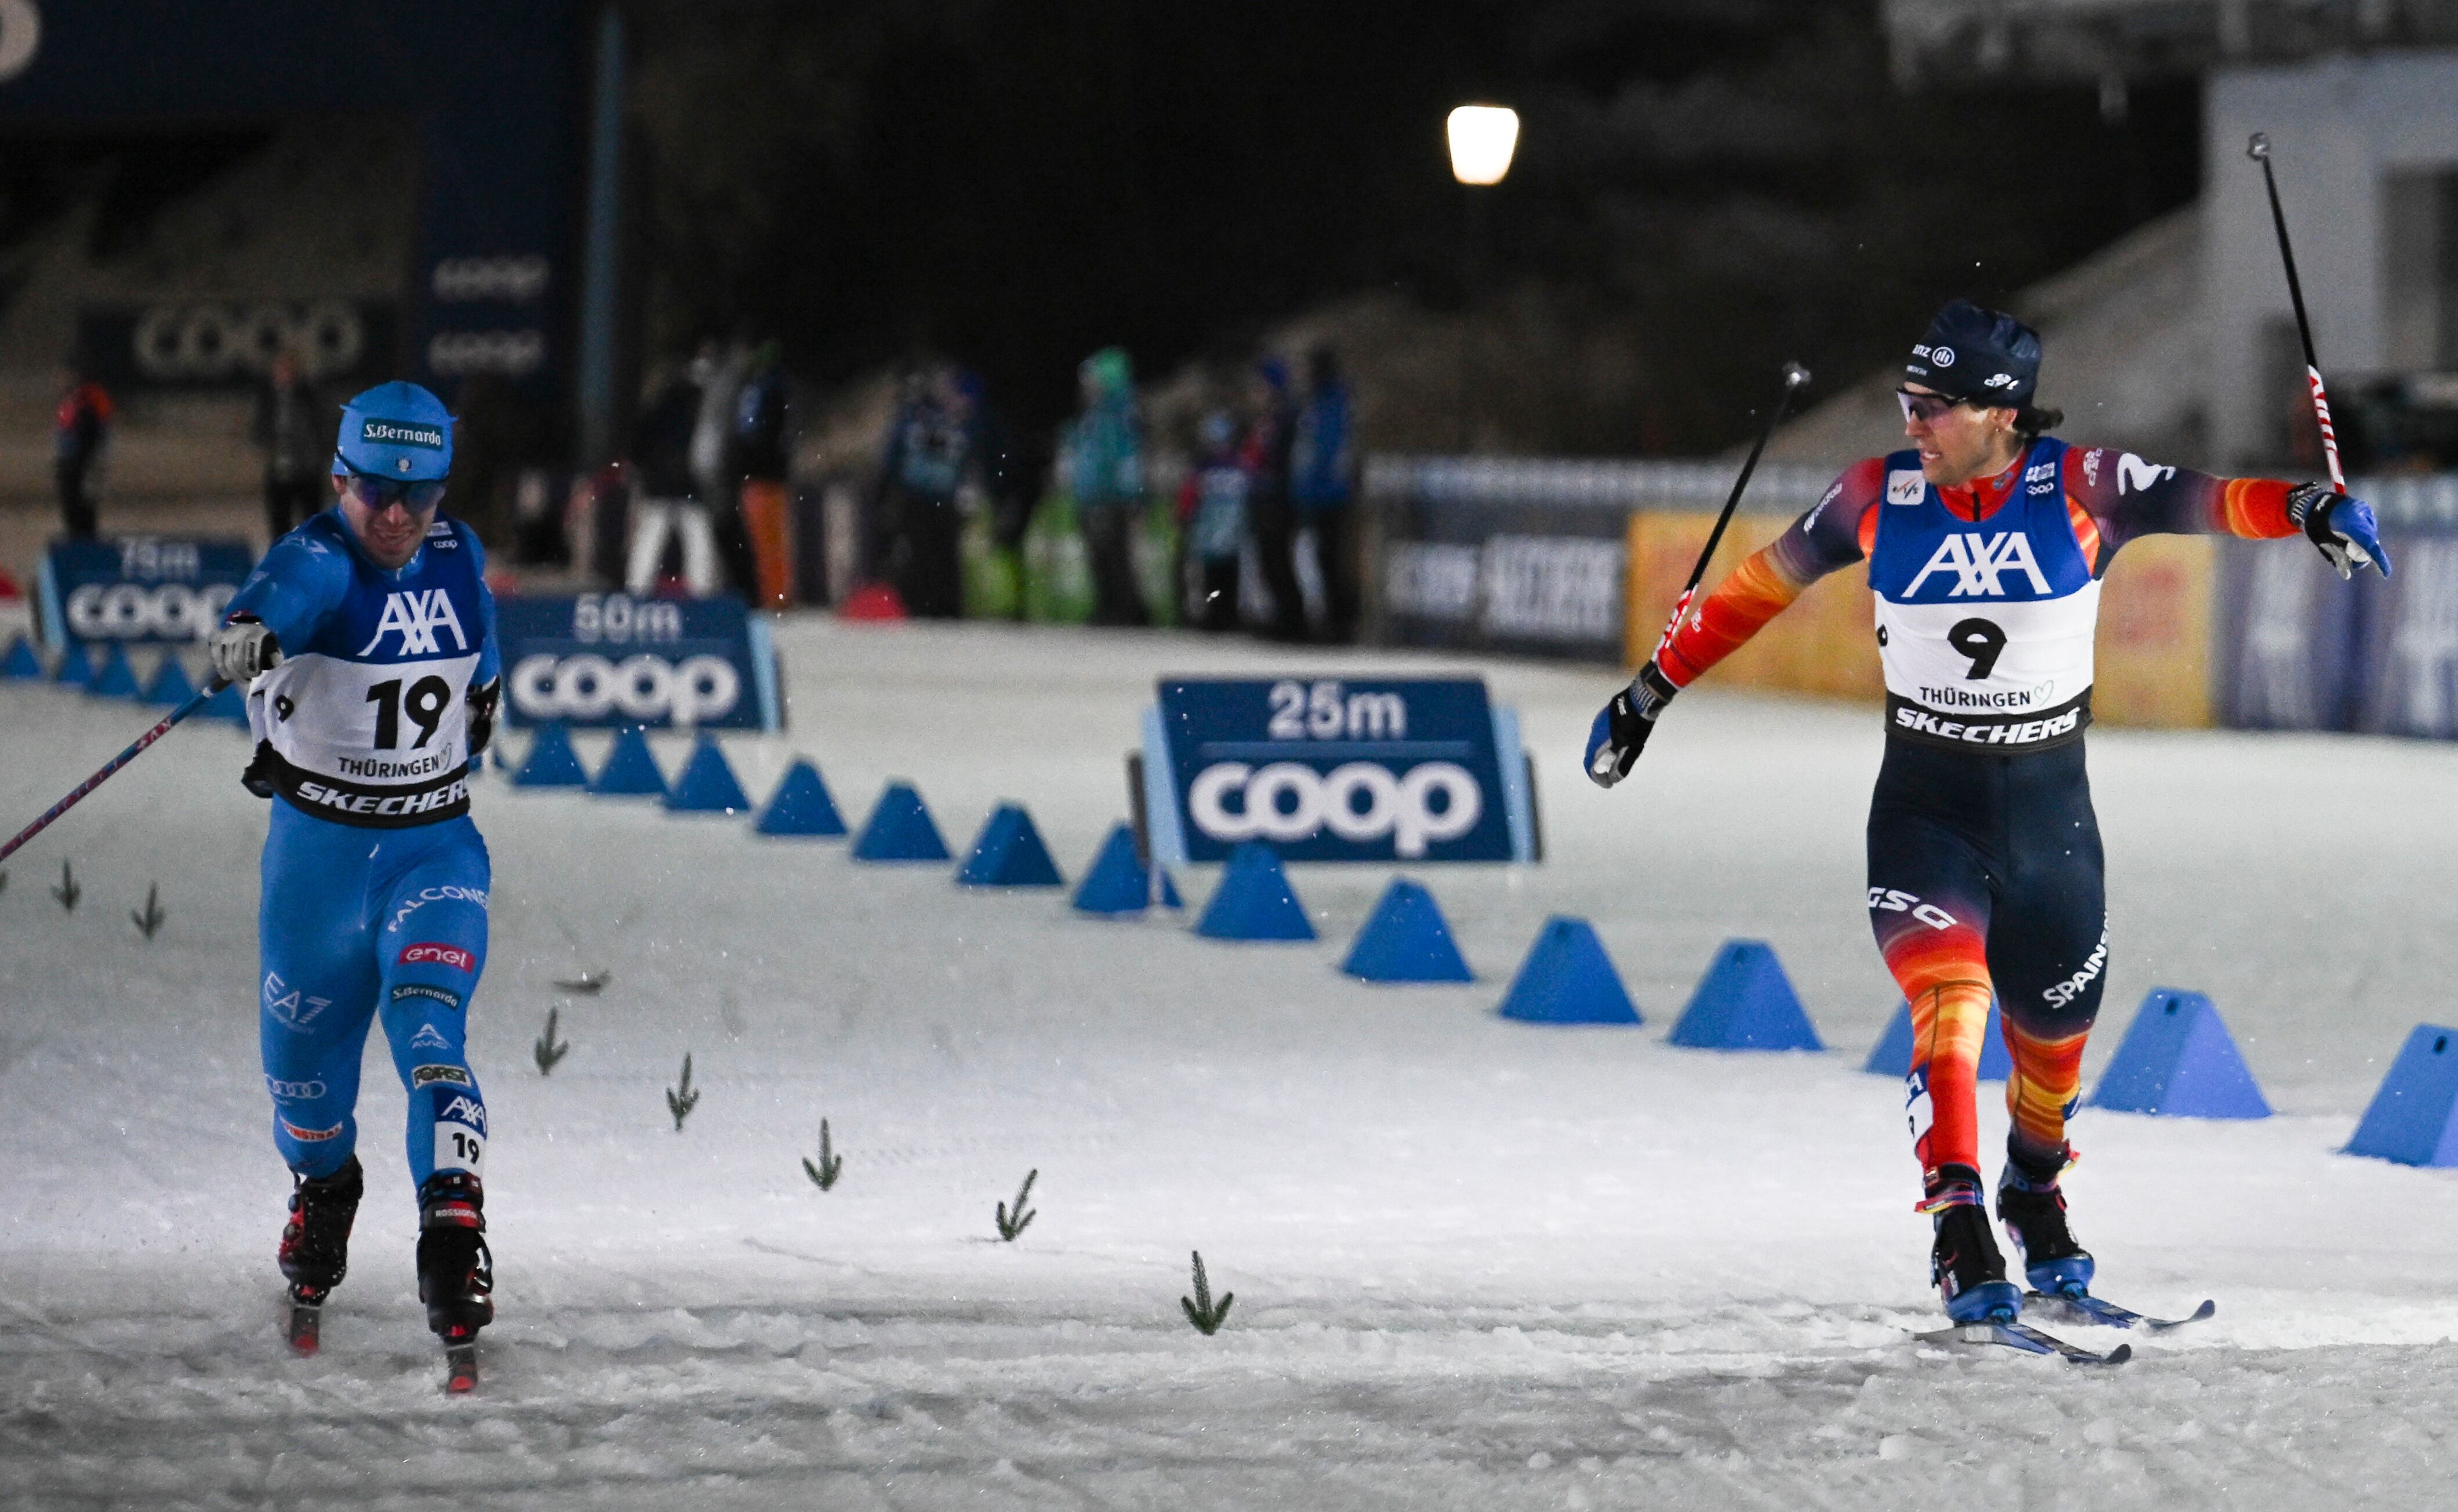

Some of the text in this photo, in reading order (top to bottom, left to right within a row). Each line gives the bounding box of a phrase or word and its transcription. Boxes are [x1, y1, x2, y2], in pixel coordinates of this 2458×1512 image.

[364, 423, 441, 446] S.Bernardo
[1901, 532, 2052, 598] AXA
[357, 589, 467, 656] AXA
[574, 593, 682, 643] 50m
[1947, 618, 2008, 680] 9
[366, 675, 450, 750] 19
[511, 654, 738, 724] coop
[1268, 681, 1405, 740] 25m
[1919, 686, 2031, 708] THÜRINGEN
[1895, 706, 2079, 744] SKECHERS
[338, 756, 440, 778] THÜRINGEN
[1190, 762, 1482, 857] coop
[406, 948, 467, 968] enel
[441, 1096, 486, 1134] AXA
[452, 1132, 480, 1164] 19
